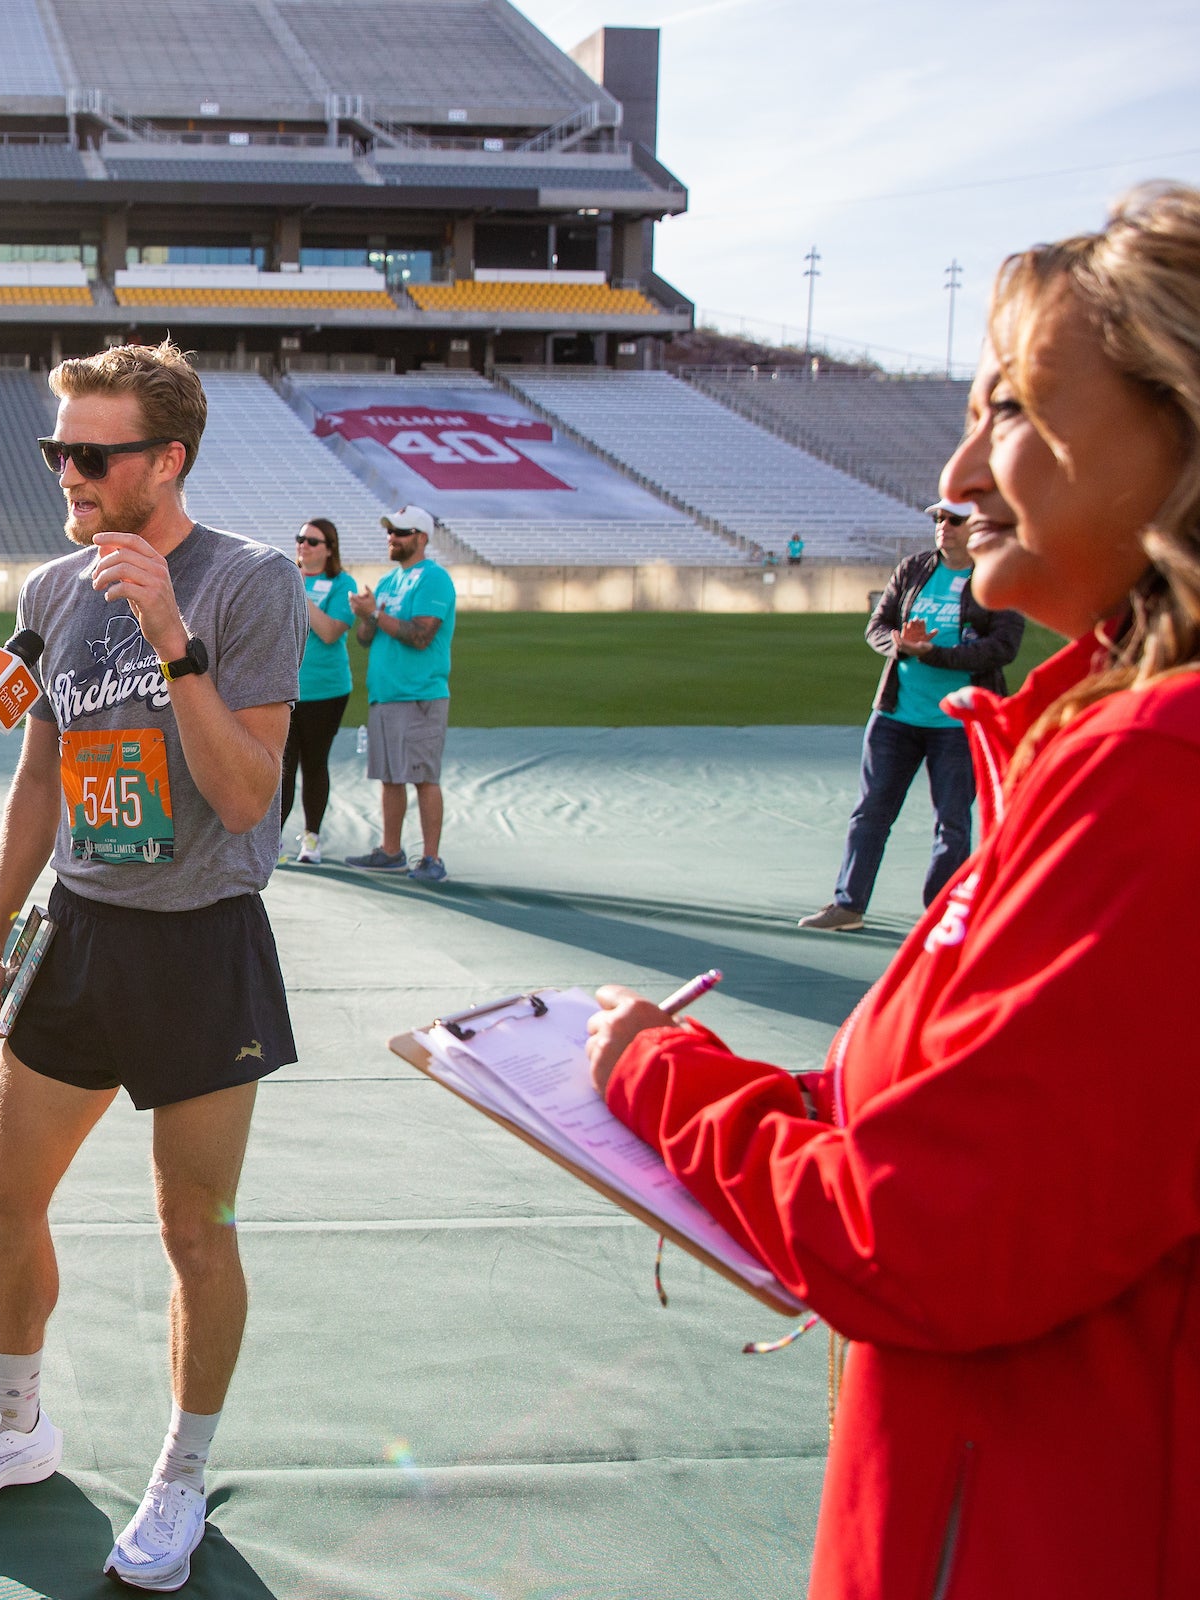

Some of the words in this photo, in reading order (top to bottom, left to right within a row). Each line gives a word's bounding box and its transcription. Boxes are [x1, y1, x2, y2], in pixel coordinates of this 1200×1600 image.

[362, 415, 468, 427] TILLMAN
[388, 430, 521, 464] 40
[11, 680, 29, 702] az
[122, 746, 138, 754] CDW
[83, 776, 141, 827] 545
[114, 844, 136, 854] LIMITS
